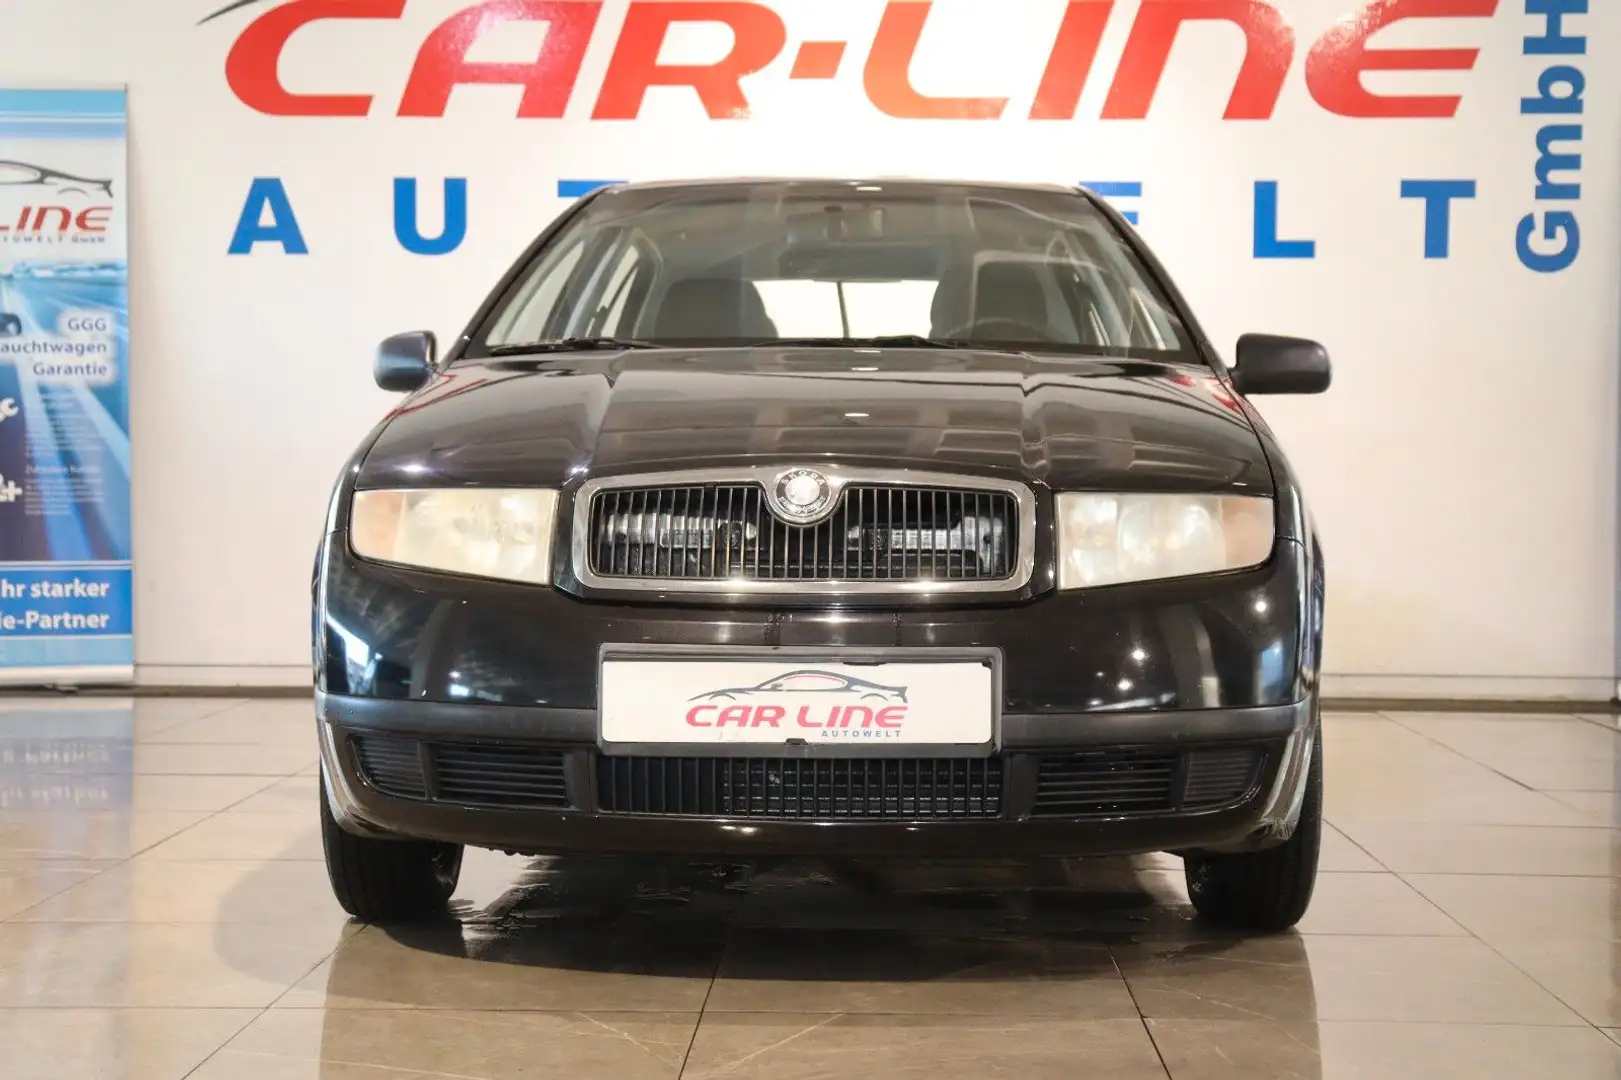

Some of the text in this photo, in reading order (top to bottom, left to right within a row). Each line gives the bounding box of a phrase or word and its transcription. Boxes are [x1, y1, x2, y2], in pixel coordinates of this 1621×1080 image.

[225, 0, 1496, 120] CAR-LINE
[1515, 0, 1588, 273] GmbH
[0, 206, 113, 231] INE
[68, 318, 107, 331] GGG
[33, 361, 107, 376] Garantie
[1, 578, 110, 598] hr starker
[685, 705, 908, 728] CAR LINE
[821, 730, 901, 738] AUTOWELT
